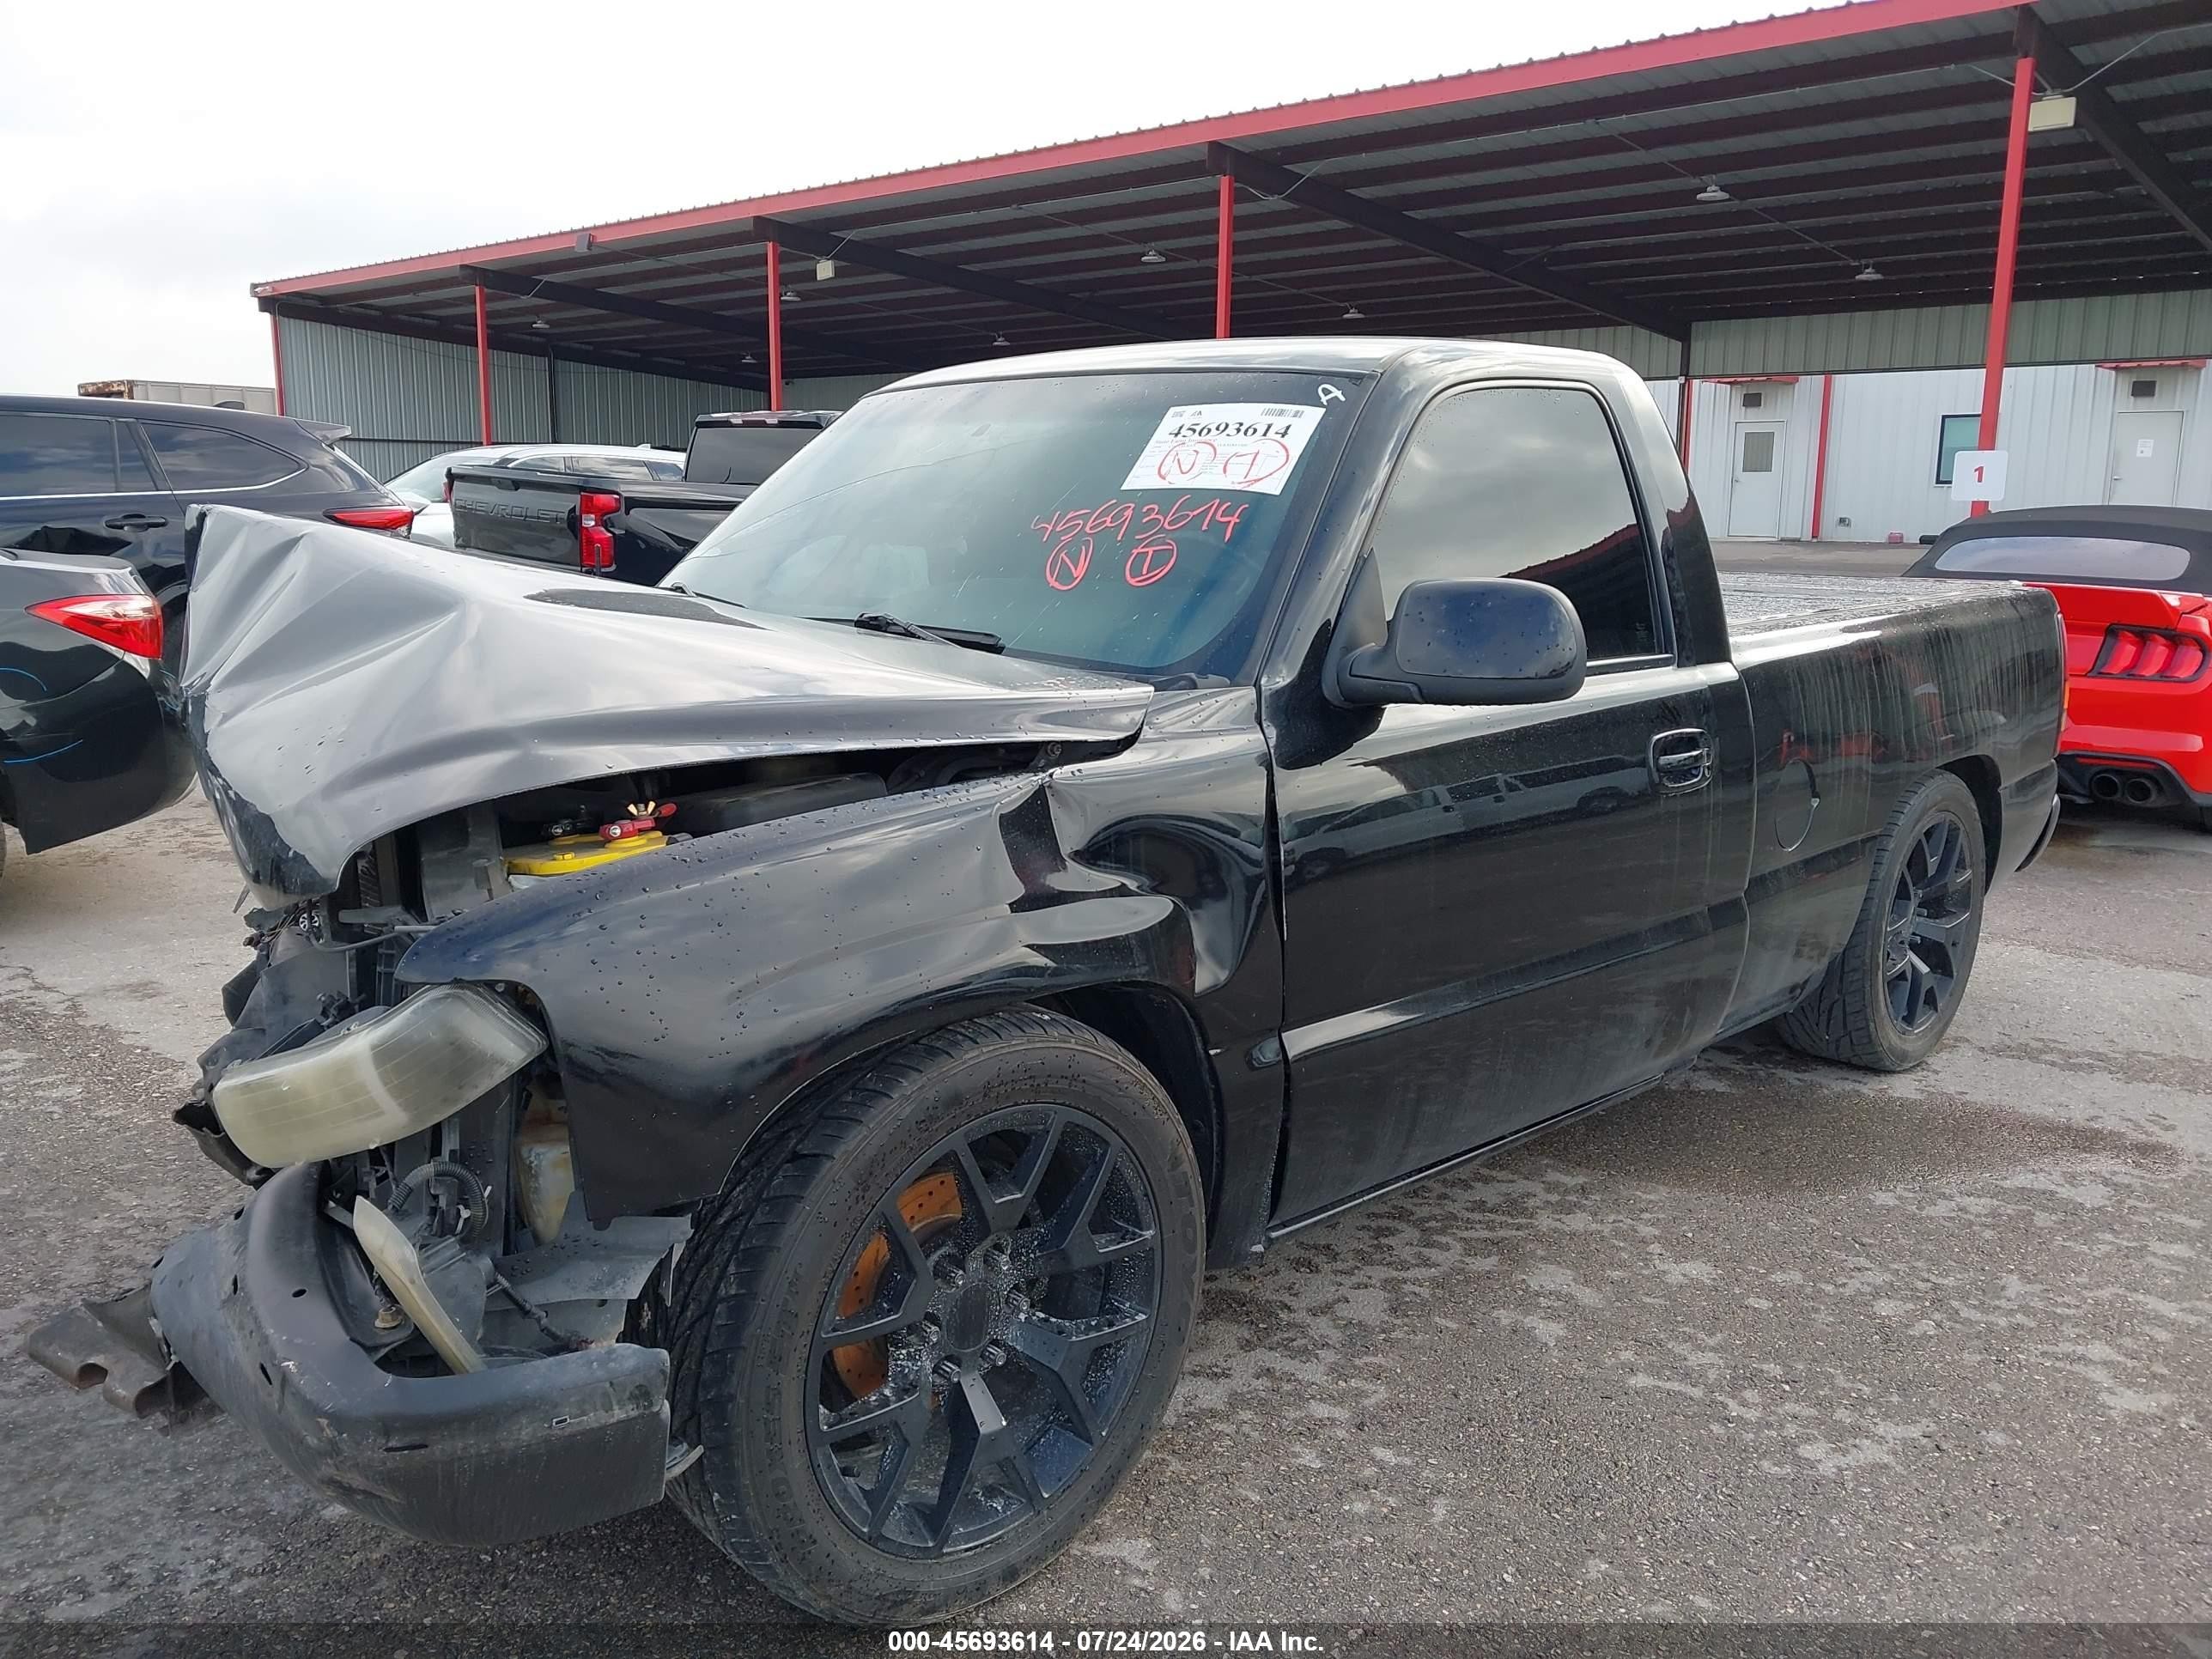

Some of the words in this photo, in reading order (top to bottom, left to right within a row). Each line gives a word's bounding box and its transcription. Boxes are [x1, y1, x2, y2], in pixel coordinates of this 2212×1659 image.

[1318, 384, 1346, 405] A
[1168, 422, 1291, 439] 45693614
[1974, 466, 1984, 483] 1
[454, 498, 566, 524] CHEVROLET
[1030, 495, 1249, 543] 45693614
